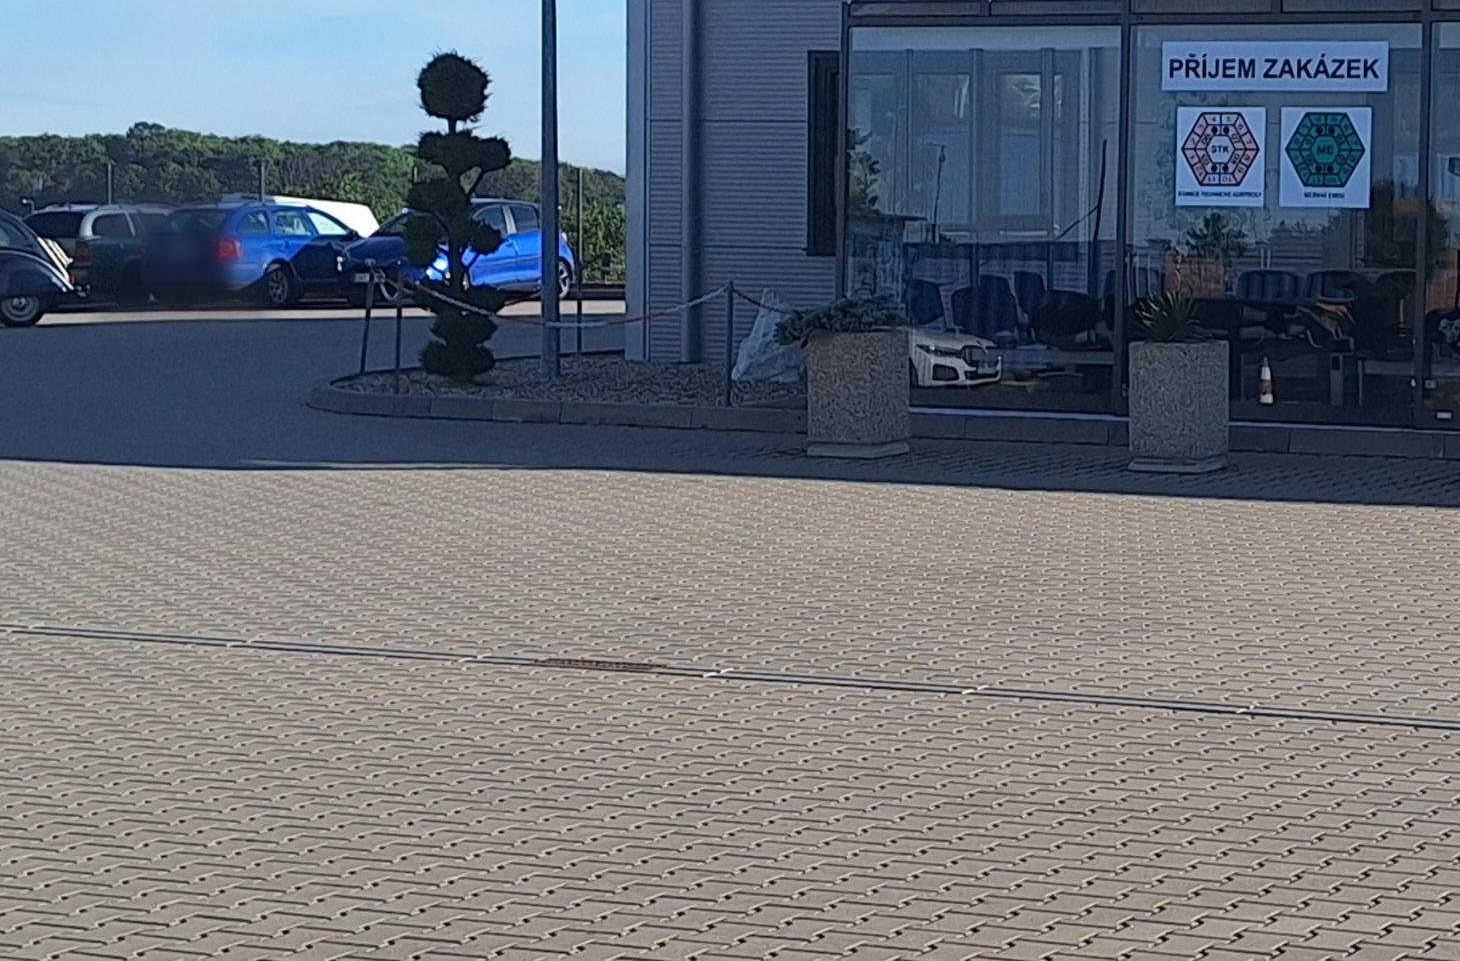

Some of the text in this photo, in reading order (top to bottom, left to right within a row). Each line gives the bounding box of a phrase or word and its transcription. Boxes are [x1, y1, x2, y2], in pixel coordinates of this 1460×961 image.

[1169, 53, 1379, 80] PŘÍJEM ZAKÁZEK
[1211, 145, 1229, 154] STK
[1317, 145, 1334, 154] ME
